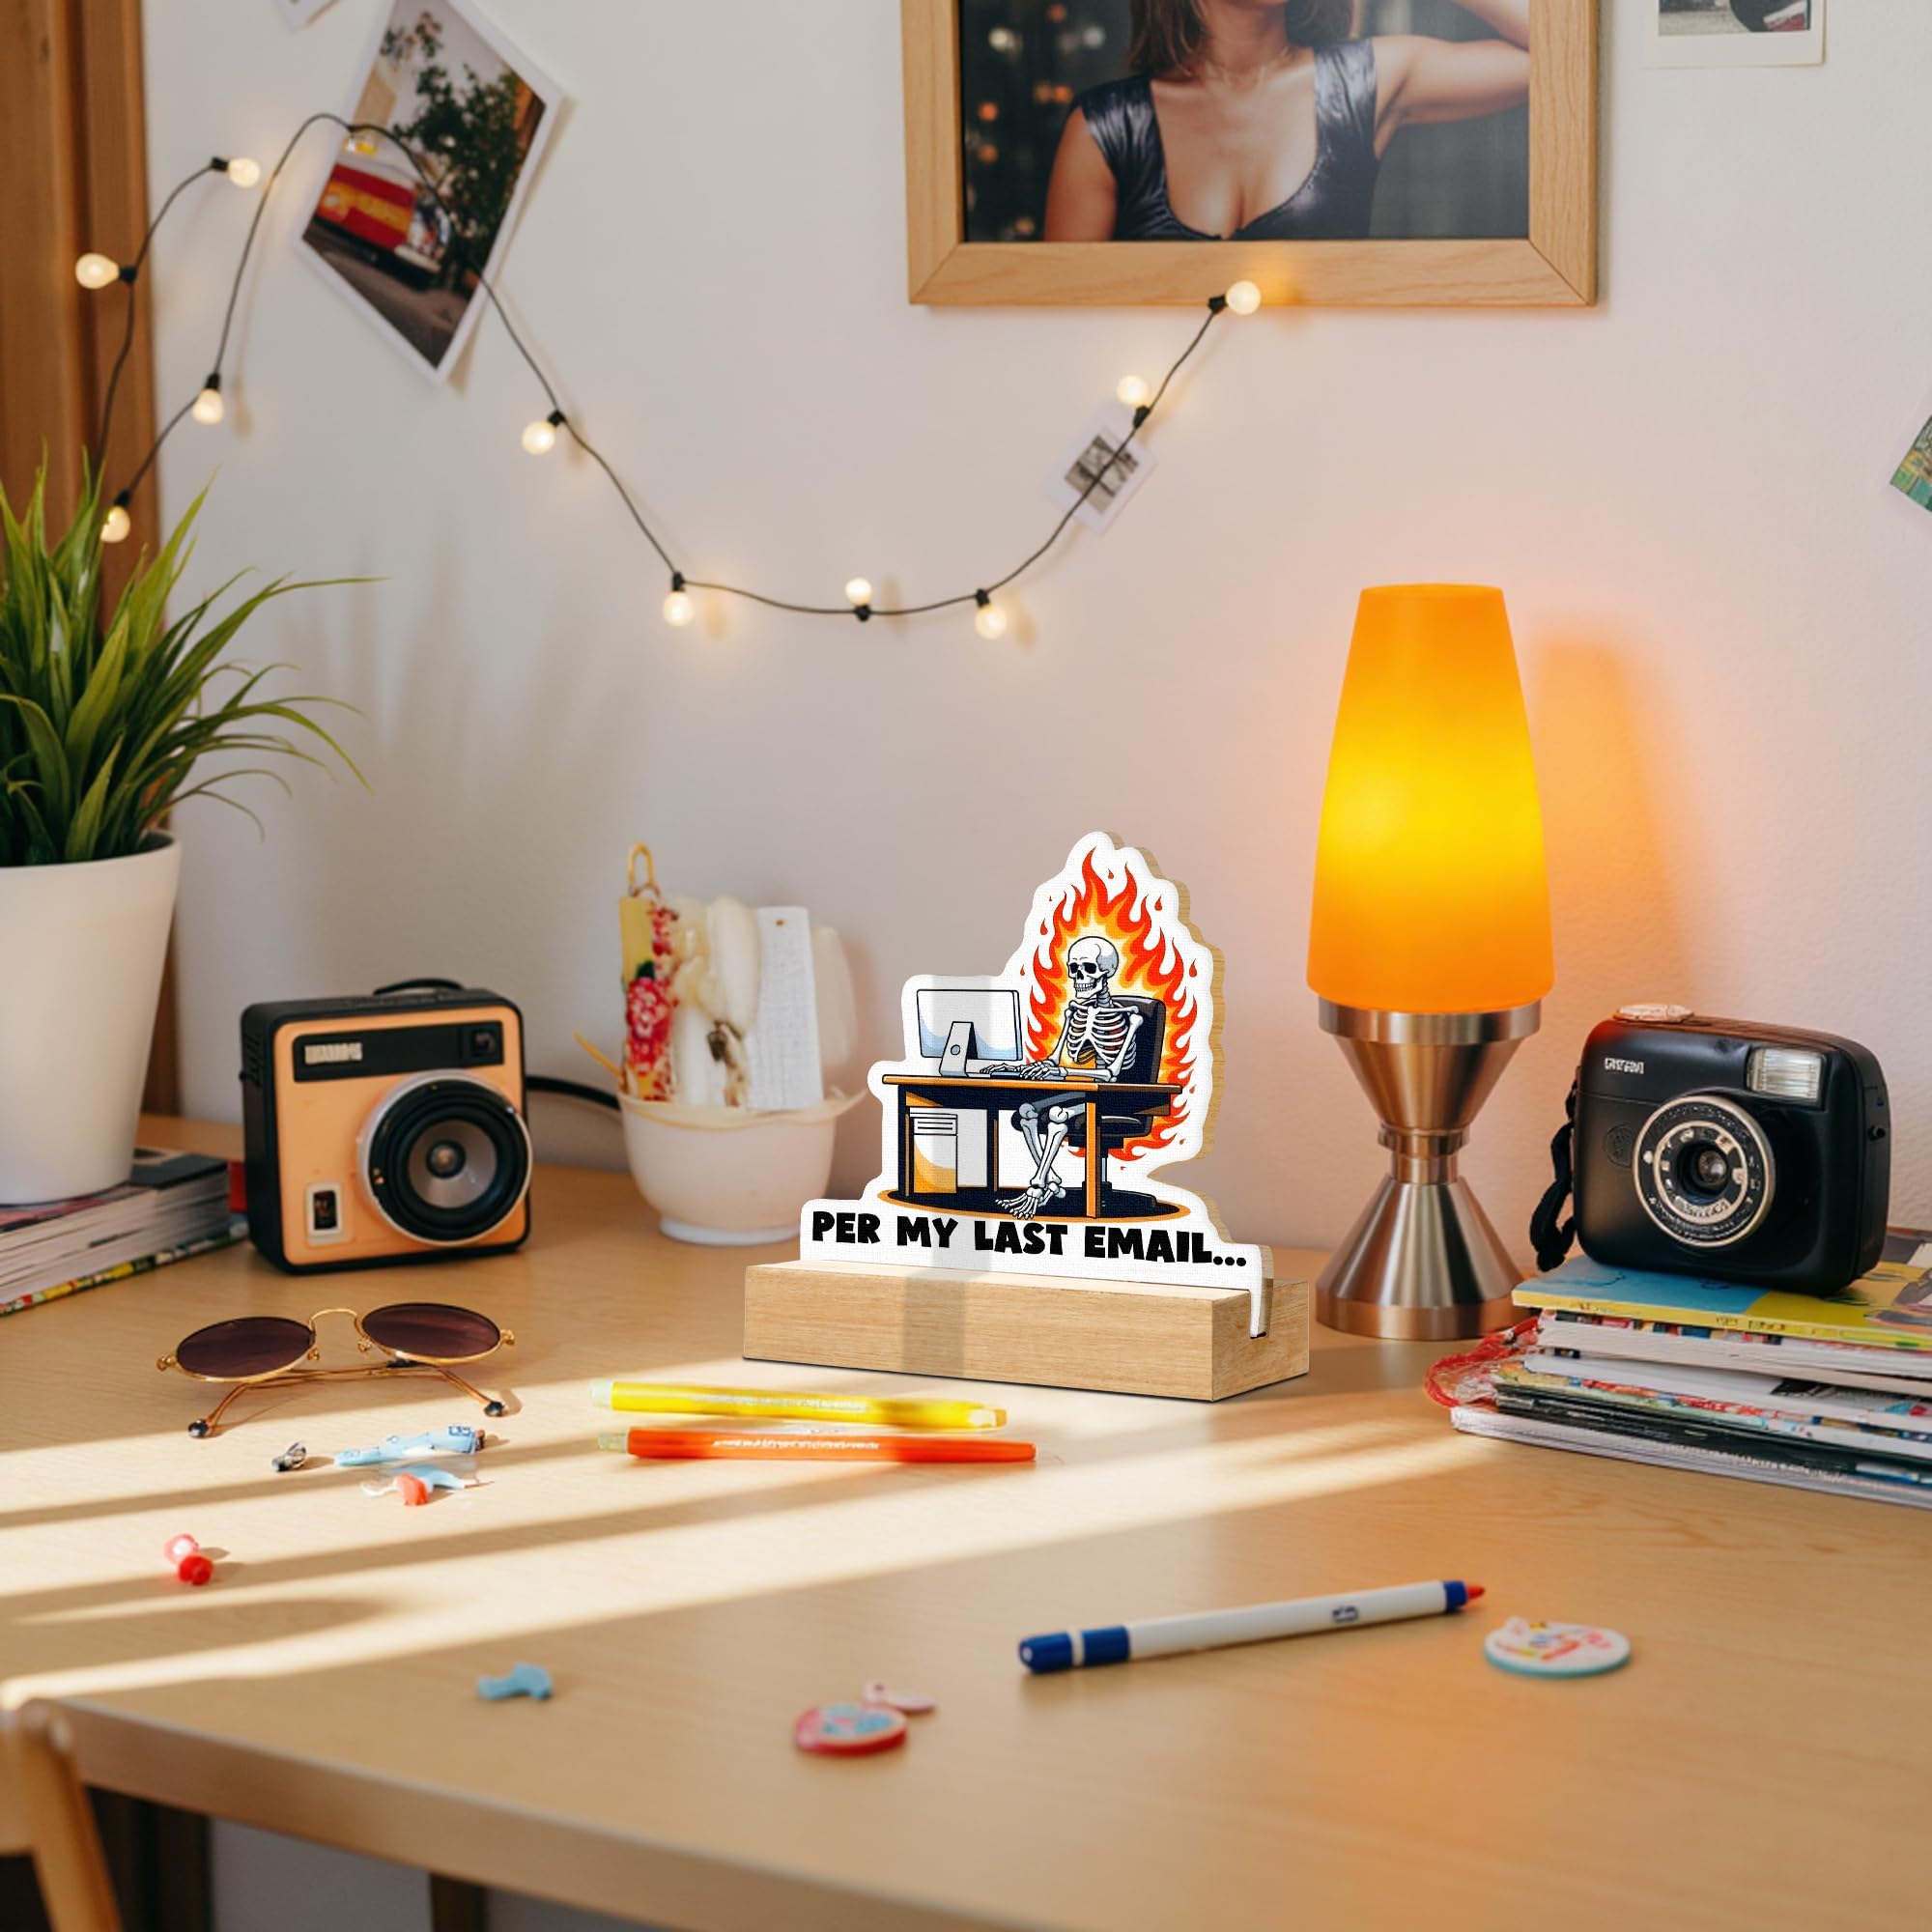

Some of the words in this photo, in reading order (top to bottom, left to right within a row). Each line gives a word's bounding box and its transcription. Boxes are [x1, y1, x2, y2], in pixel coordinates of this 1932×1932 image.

[812, 1210, 881, 1244] PER
[896, 1215, 959, 1248] MY
[974, 1220, 1068, 1256] LAST
[1084, 1225, 1247, 1267] EMAIL...
